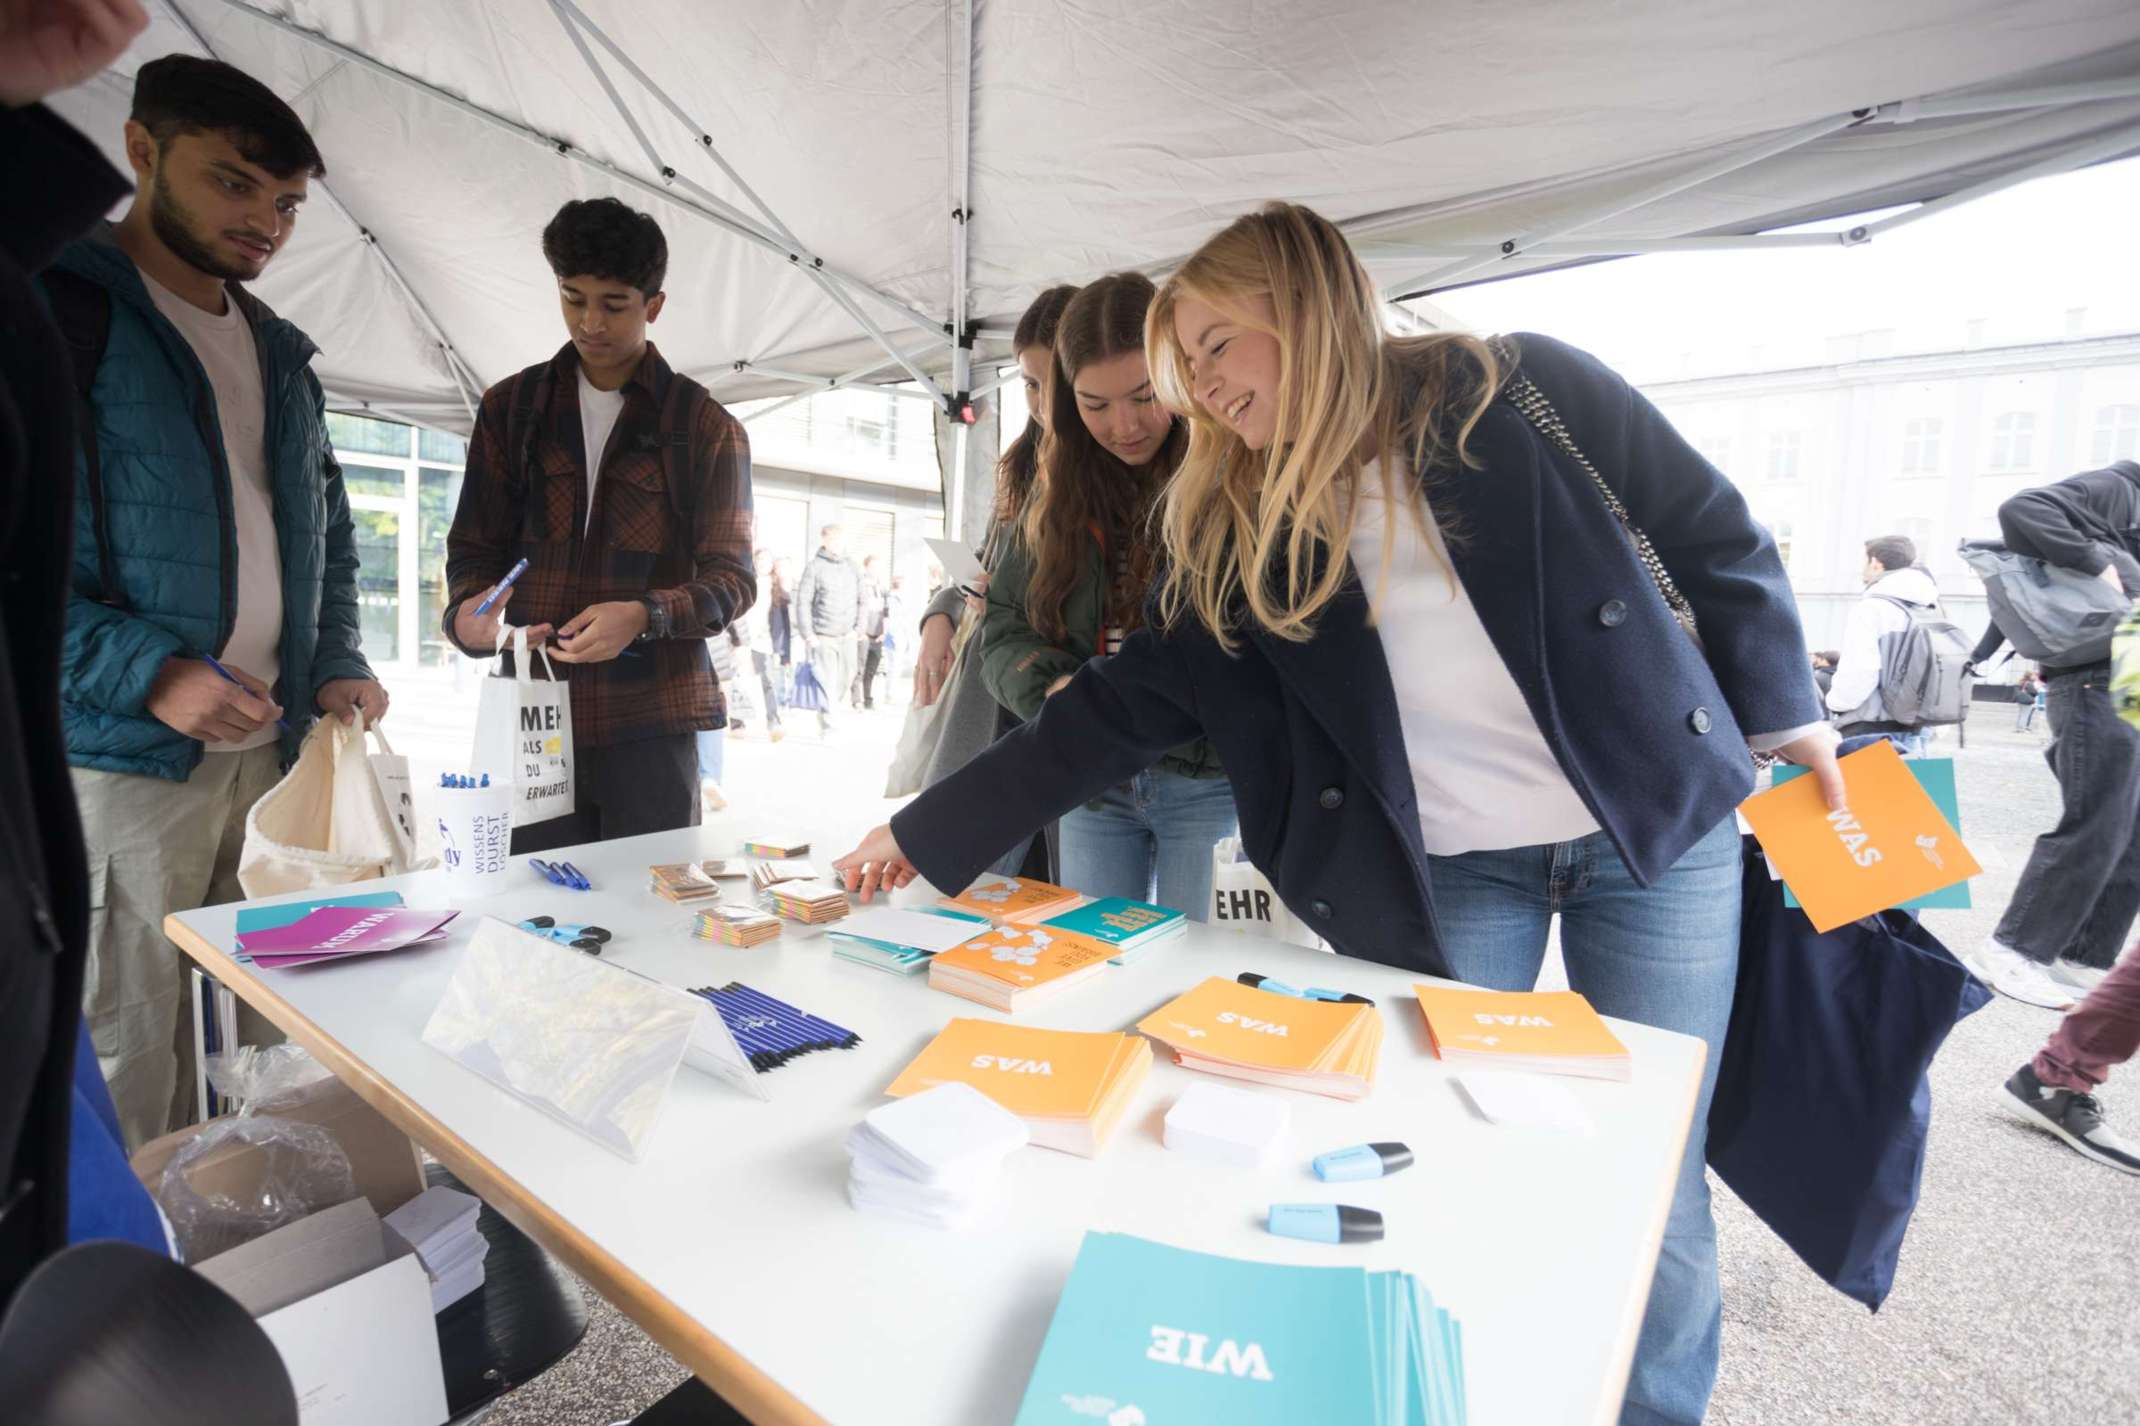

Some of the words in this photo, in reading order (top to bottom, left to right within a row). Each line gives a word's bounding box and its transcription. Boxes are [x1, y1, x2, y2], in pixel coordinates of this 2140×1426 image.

[523, 740, 543, 754] ALS
[526, 763, 541, 777] DU
[526, 780, 569, 801] ERWARTE
[473, 815, 485, 874] WISSENS
[487, 815, 500, 873] DURST
[1827, 805, 1883, 867] WAS
[1216, 1012, 1288, 1037] WAS
[1473, 1013, 1555, 1028] WAS
[970, 1055, 1053, 1075] WAS
[1146, 1324, 1275, 1381] WIE
